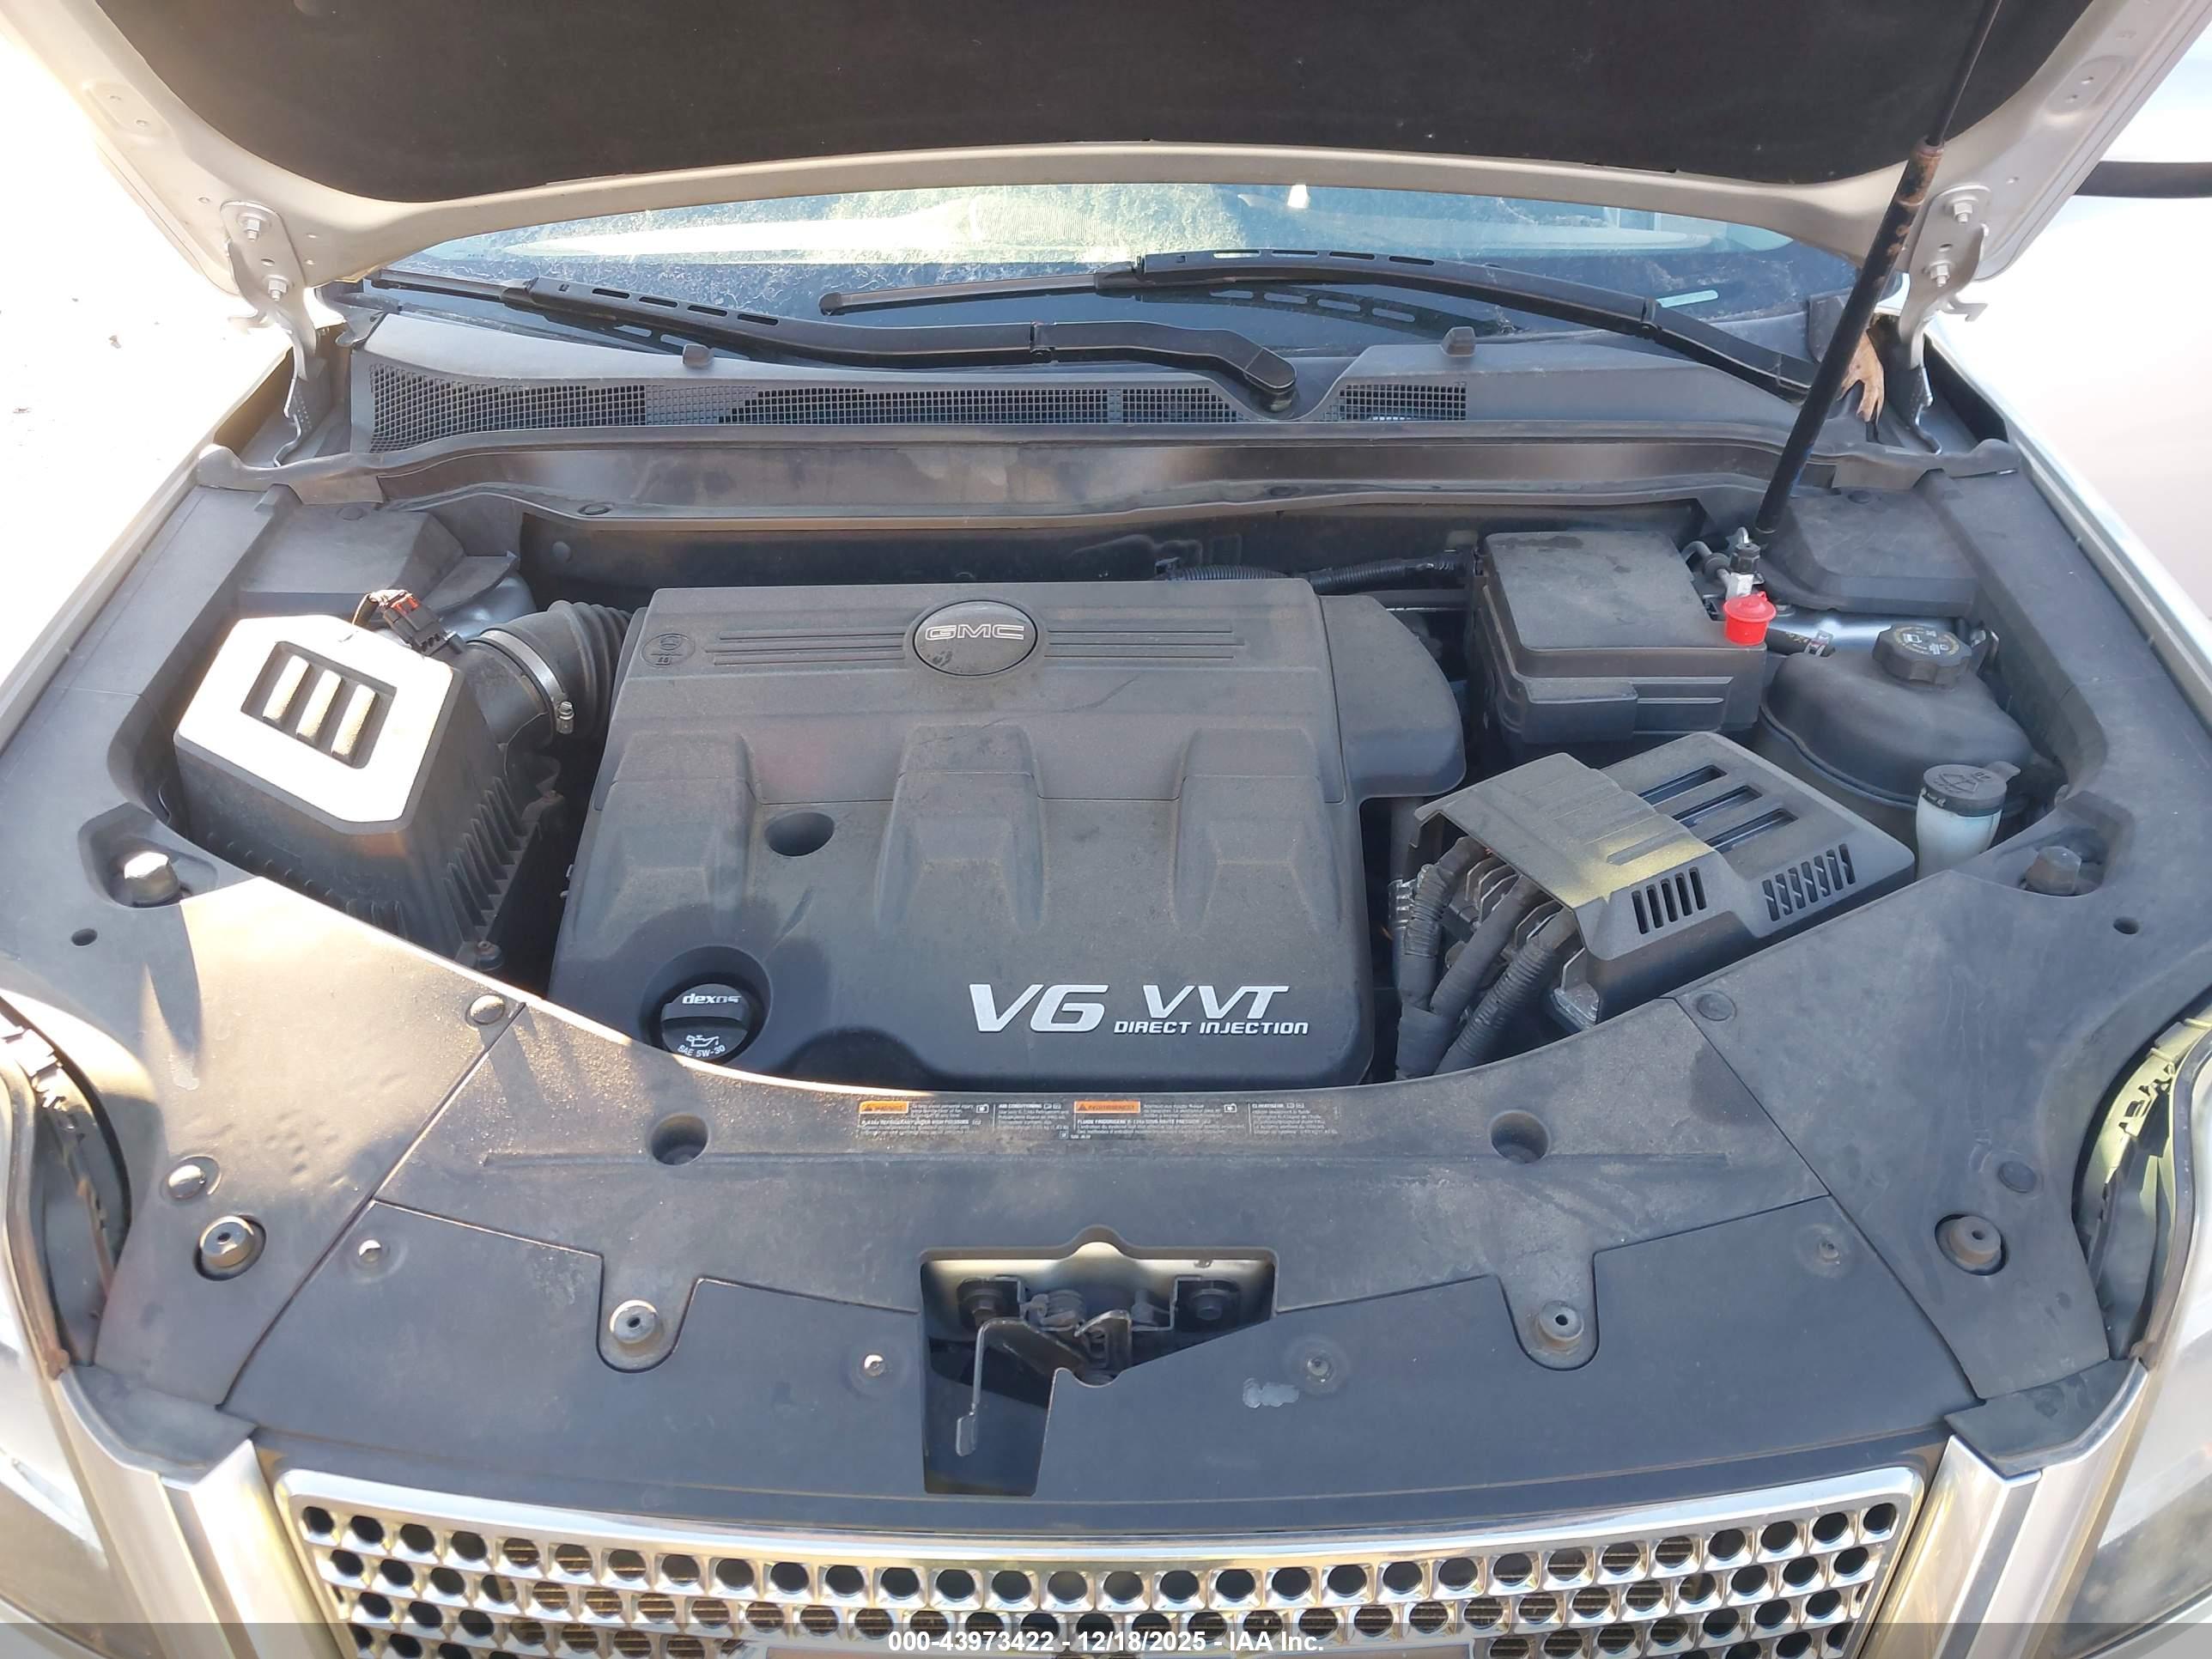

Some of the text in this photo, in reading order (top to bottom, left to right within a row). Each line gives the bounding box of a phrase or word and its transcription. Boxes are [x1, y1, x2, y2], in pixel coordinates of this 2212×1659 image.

[926, 623, 1024, 641] GMC
[682, 993, 743, 1005] dexos
[969, 983, 1289, 1032] V6 VVT
[1114, 1021, 1309, 1035] DIRECT INJECTION
[678, 1044, 726, 1058] SAE 5W-30
